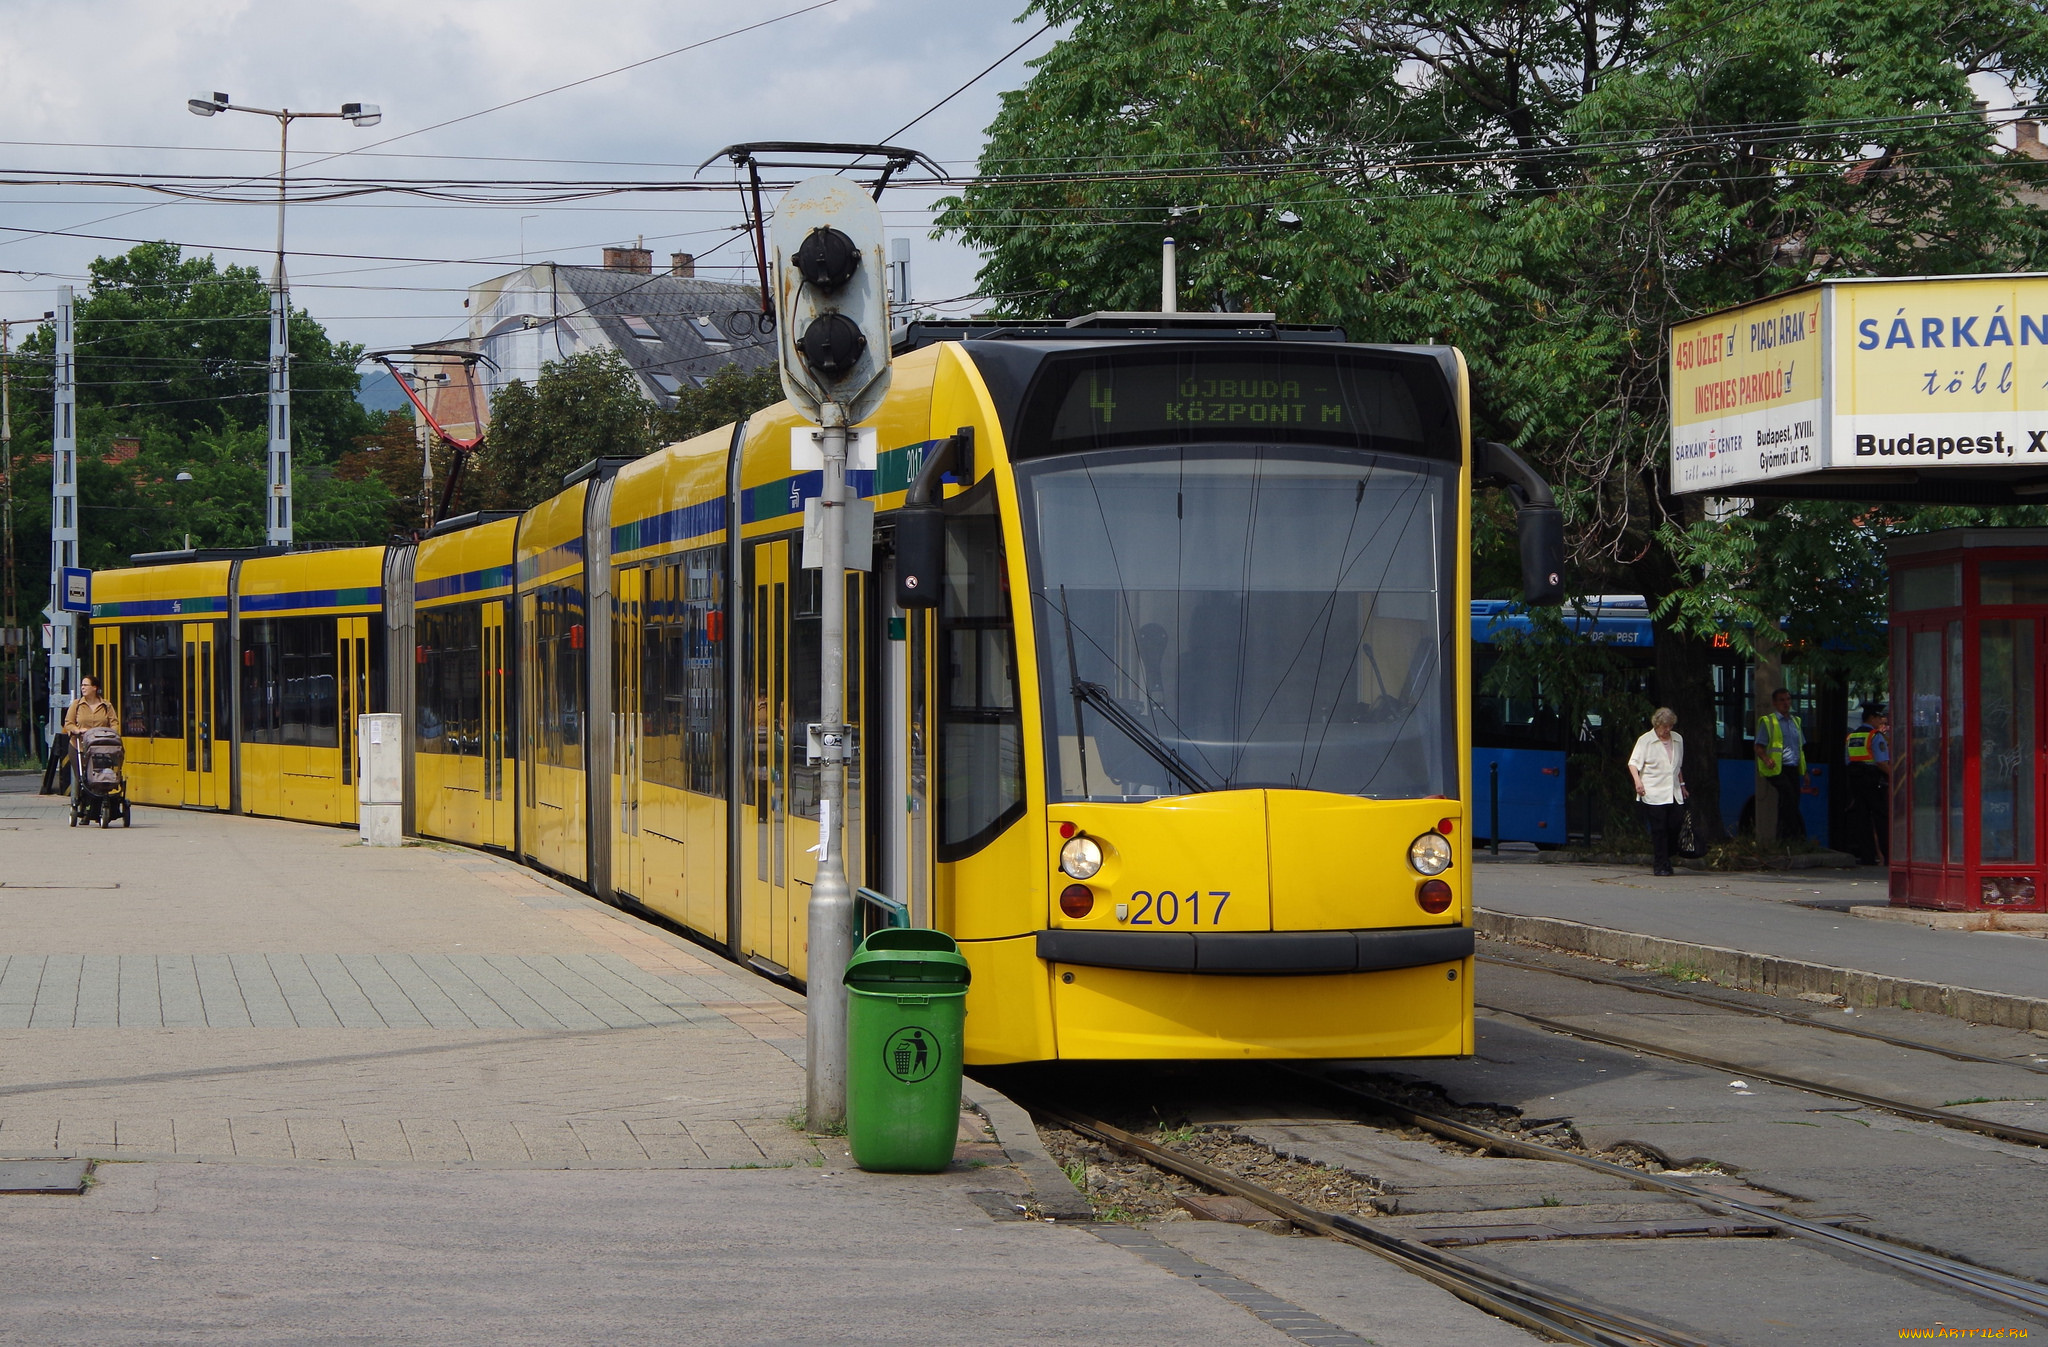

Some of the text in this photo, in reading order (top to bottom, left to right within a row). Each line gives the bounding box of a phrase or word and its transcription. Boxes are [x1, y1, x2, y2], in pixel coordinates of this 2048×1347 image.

[1751, 309, 1805, 352] PIACI ÁRAK
[1676, 331, 1723, 371] 450 ÜZLET
[1695, 361, 1783, 415] INGYENES PARKOLÓ
[1921, 361, 2013, 395] több
[1090, 375, 1116, 422] 4
[1166, 401, 1341, 422] KÖZPONT M
[1675, 435, 1743, 461] SÁRKÁNY CENTER
[1757, 420, 1814, 448] Budapest, XVIII.
[1856, 430, 2048, 459] Budapest, X
[907, 447, 923, 483] 2017
[1790, 445, 1799, 465] út
[1800, 445, 1811, 463] 79.
[1130, 890, 1231, 925] 2017
